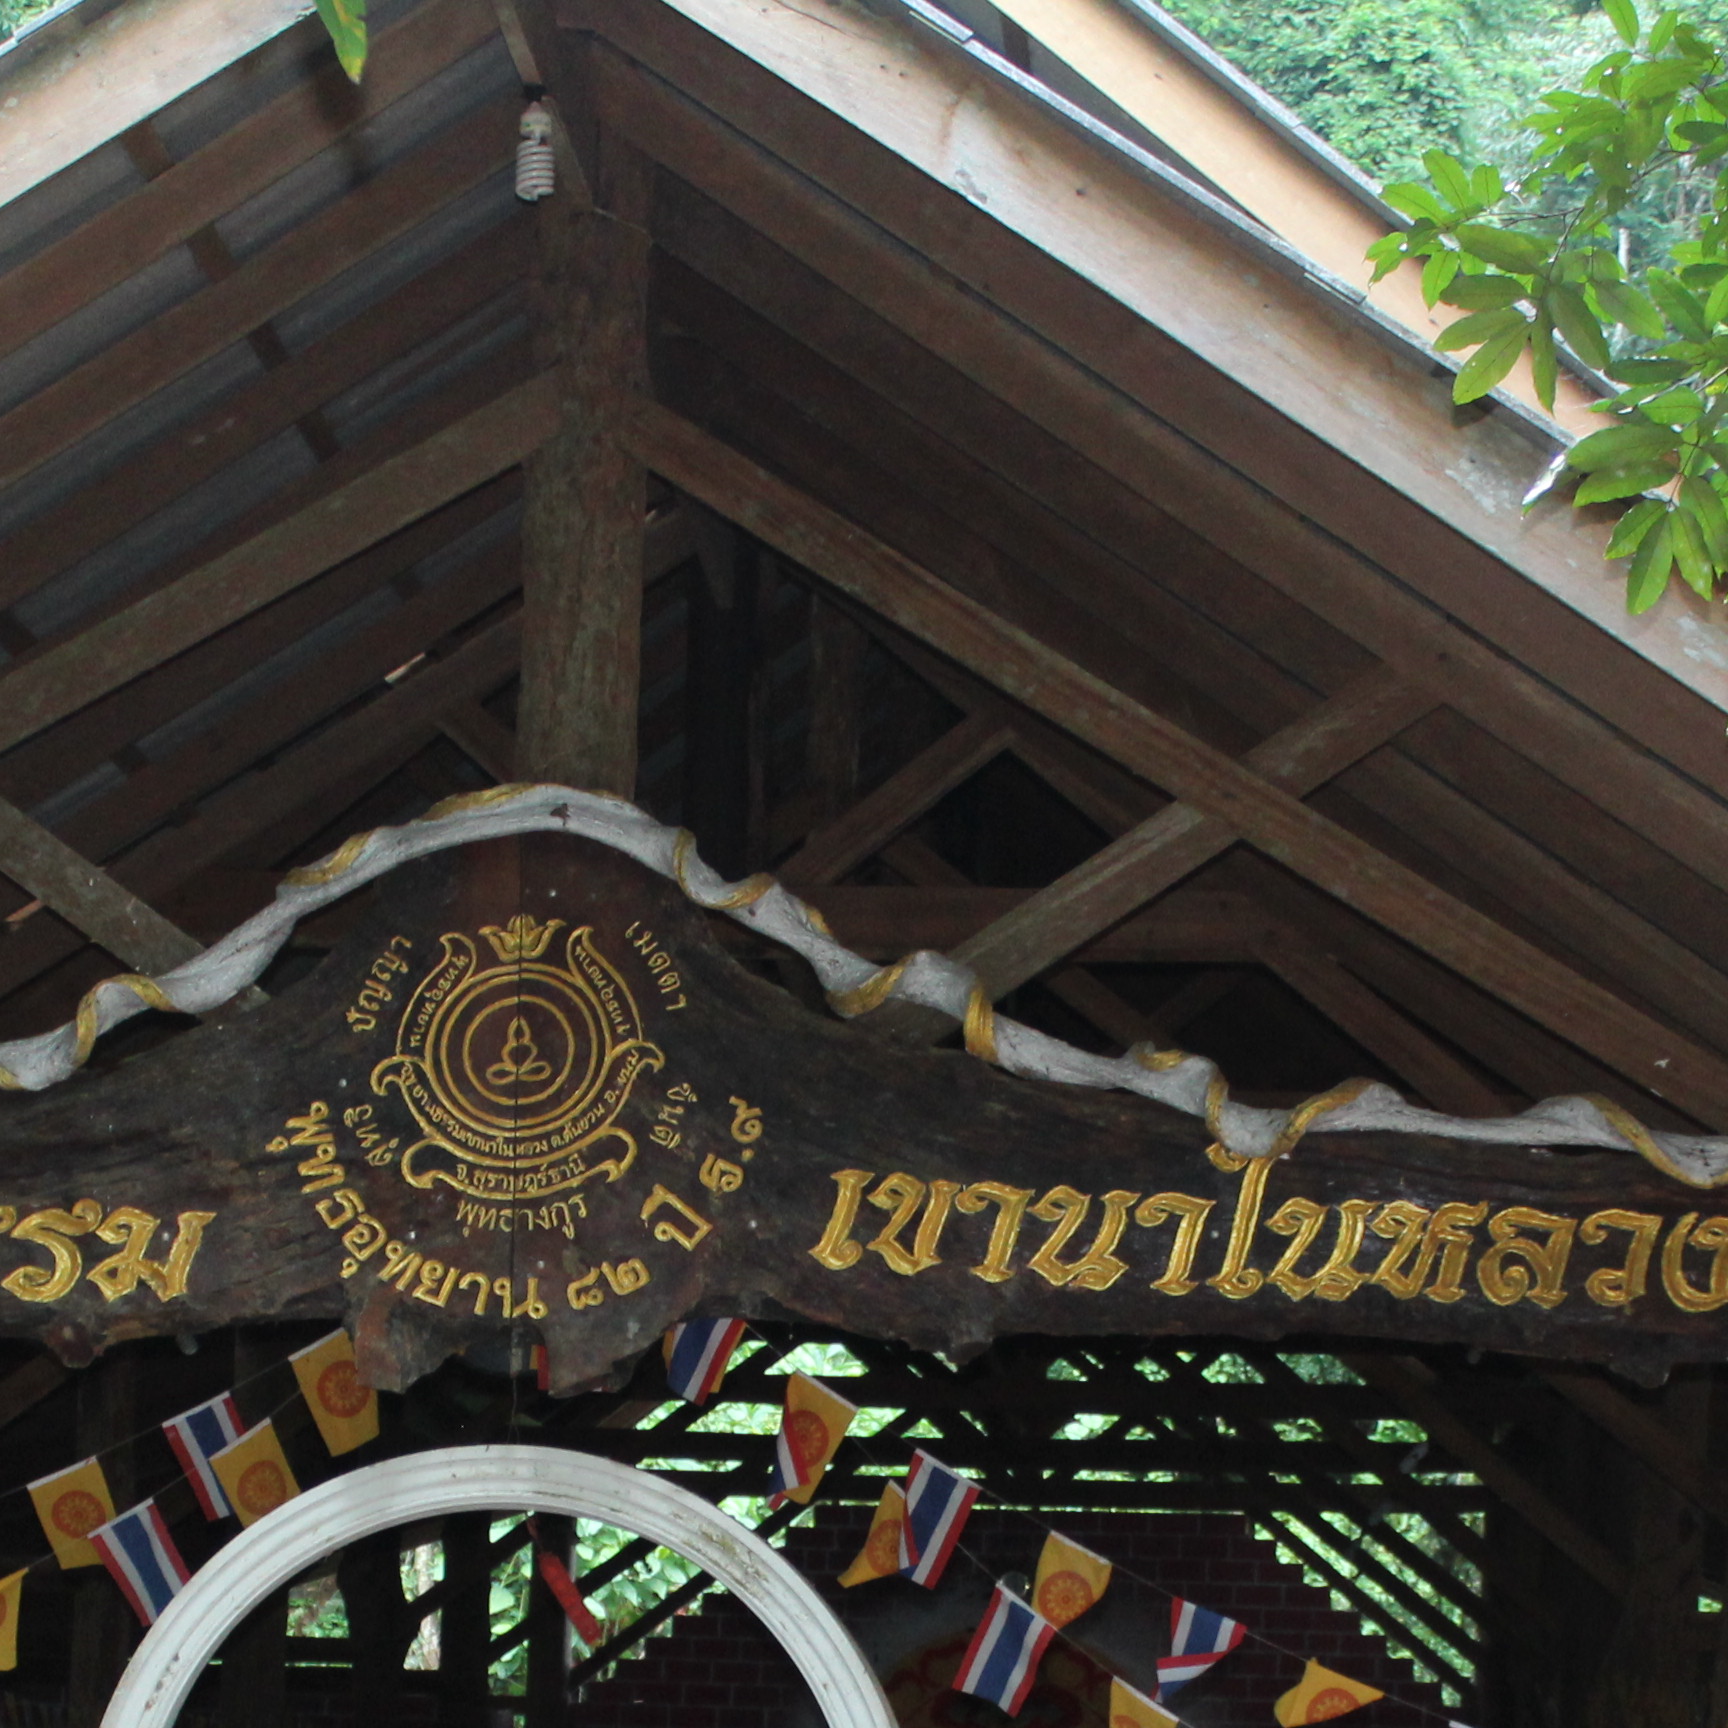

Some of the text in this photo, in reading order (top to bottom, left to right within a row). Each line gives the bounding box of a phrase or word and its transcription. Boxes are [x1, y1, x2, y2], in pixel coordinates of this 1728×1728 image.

[346, 936, 412, 1032] ปัญญา
[265, 1101, 548, 1319] พุทธอุทยาน
